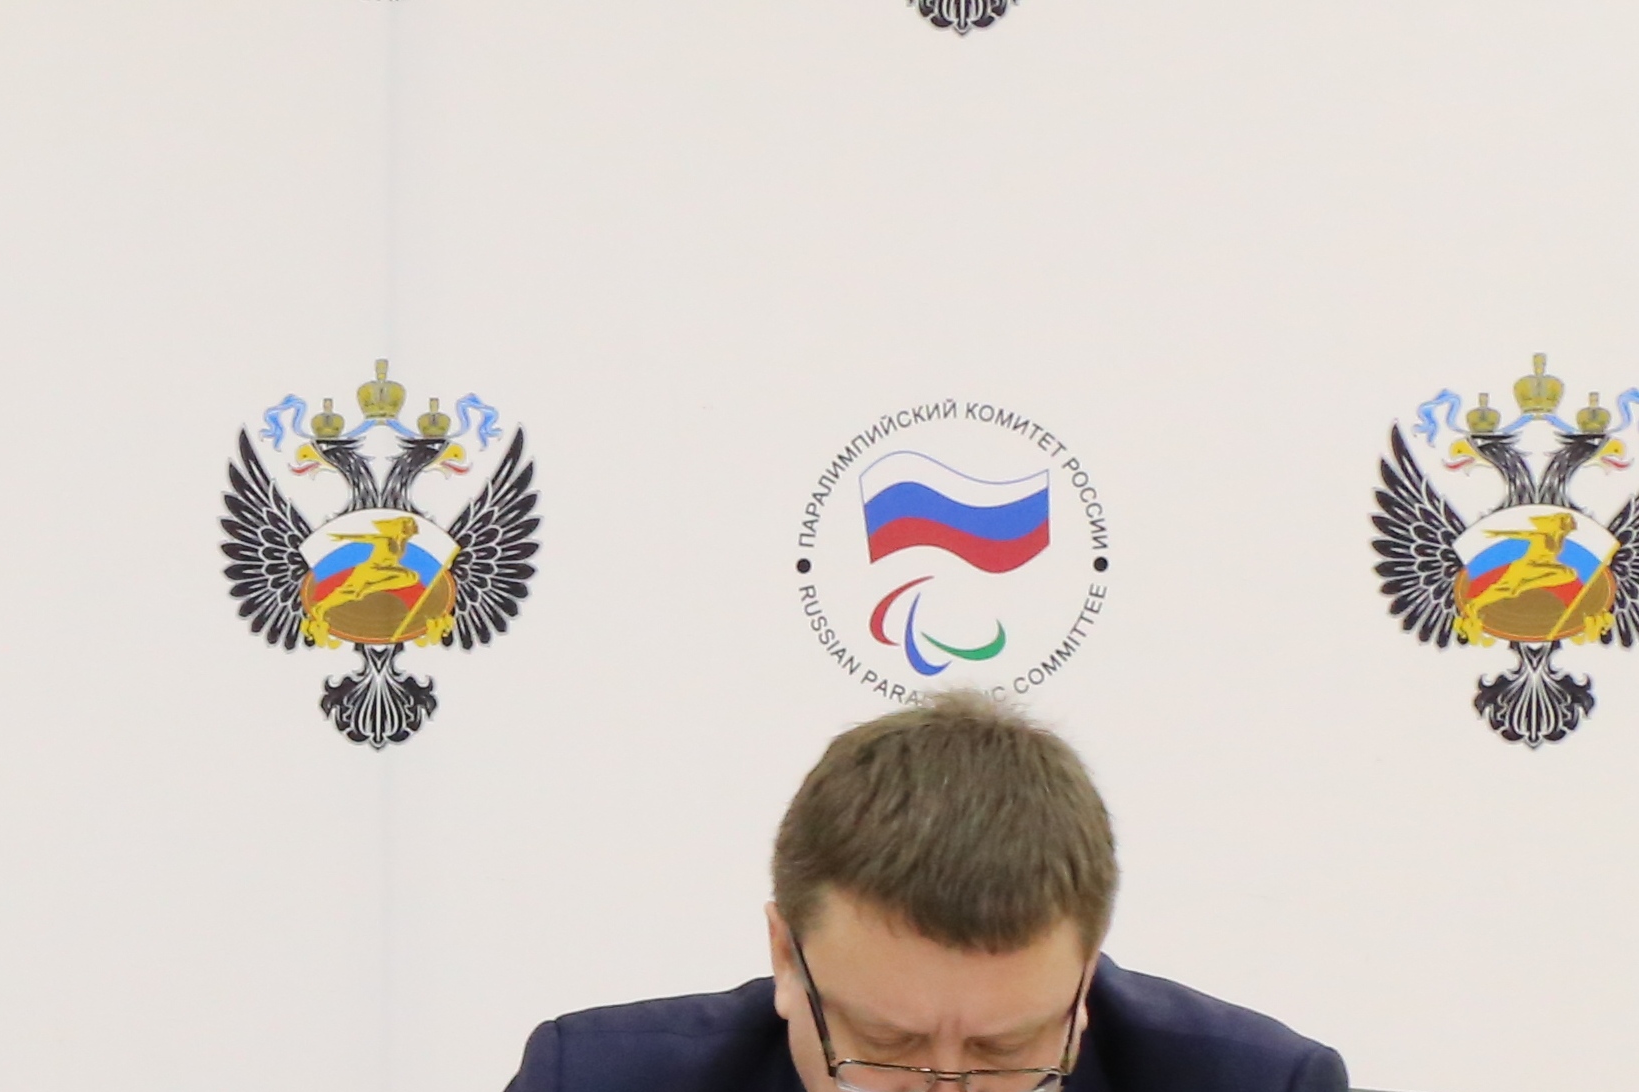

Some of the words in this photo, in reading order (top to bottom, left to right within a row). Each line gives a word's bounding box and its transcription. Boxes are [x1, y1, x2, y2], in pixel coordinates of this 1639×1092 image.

[799, 398, 957, 547] ПАРАЛИМПИЙСКИЙ
[965, 402, 1067, 458] КОМИТЕТ
[1061, 457, 1108, 550] РОССИИ
[799, 584, 862, 675] RUSSIAN
[1013, 583, 1107, 694] COMMITTEE
